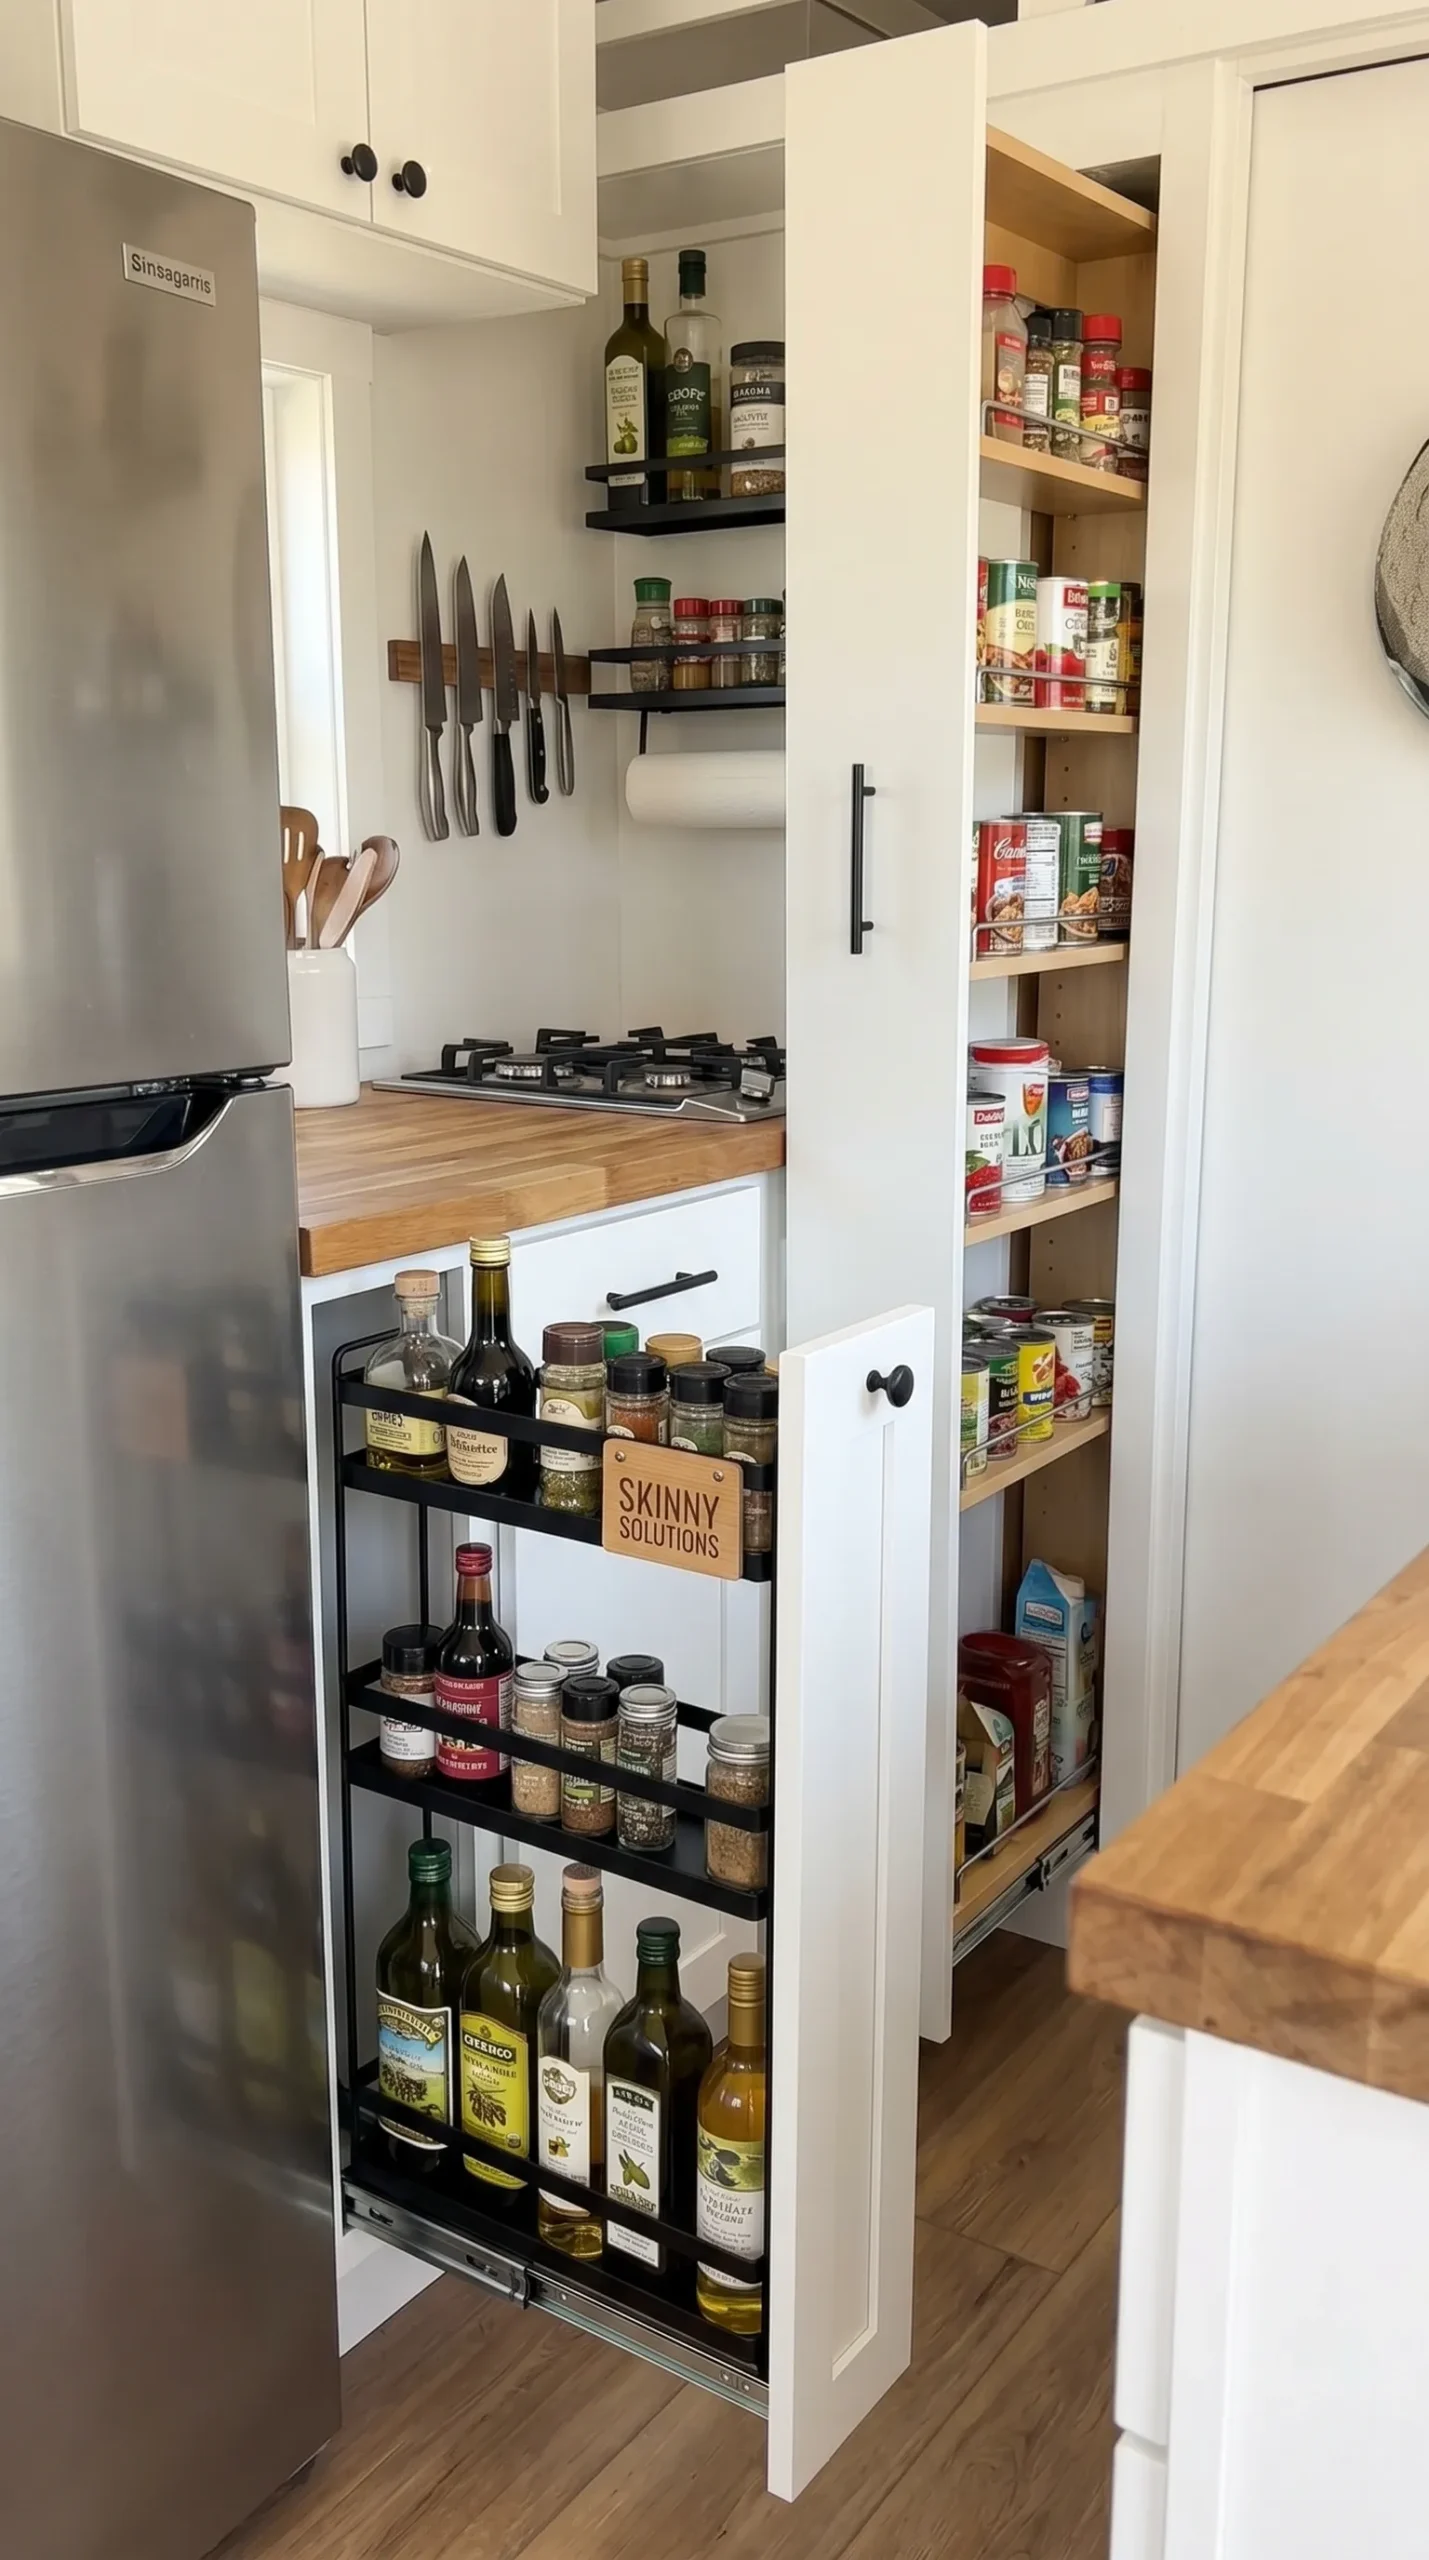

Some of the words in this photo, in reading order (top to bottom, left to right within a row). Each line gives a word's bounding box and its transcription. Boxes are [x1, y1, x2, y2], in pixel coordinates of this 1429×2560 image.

[131, 253, 212, 294] Sinsagarris
[619, 1477, 720, 1530] SKINNY
[619, 1515, 719, 1559] SOLUTIONS
